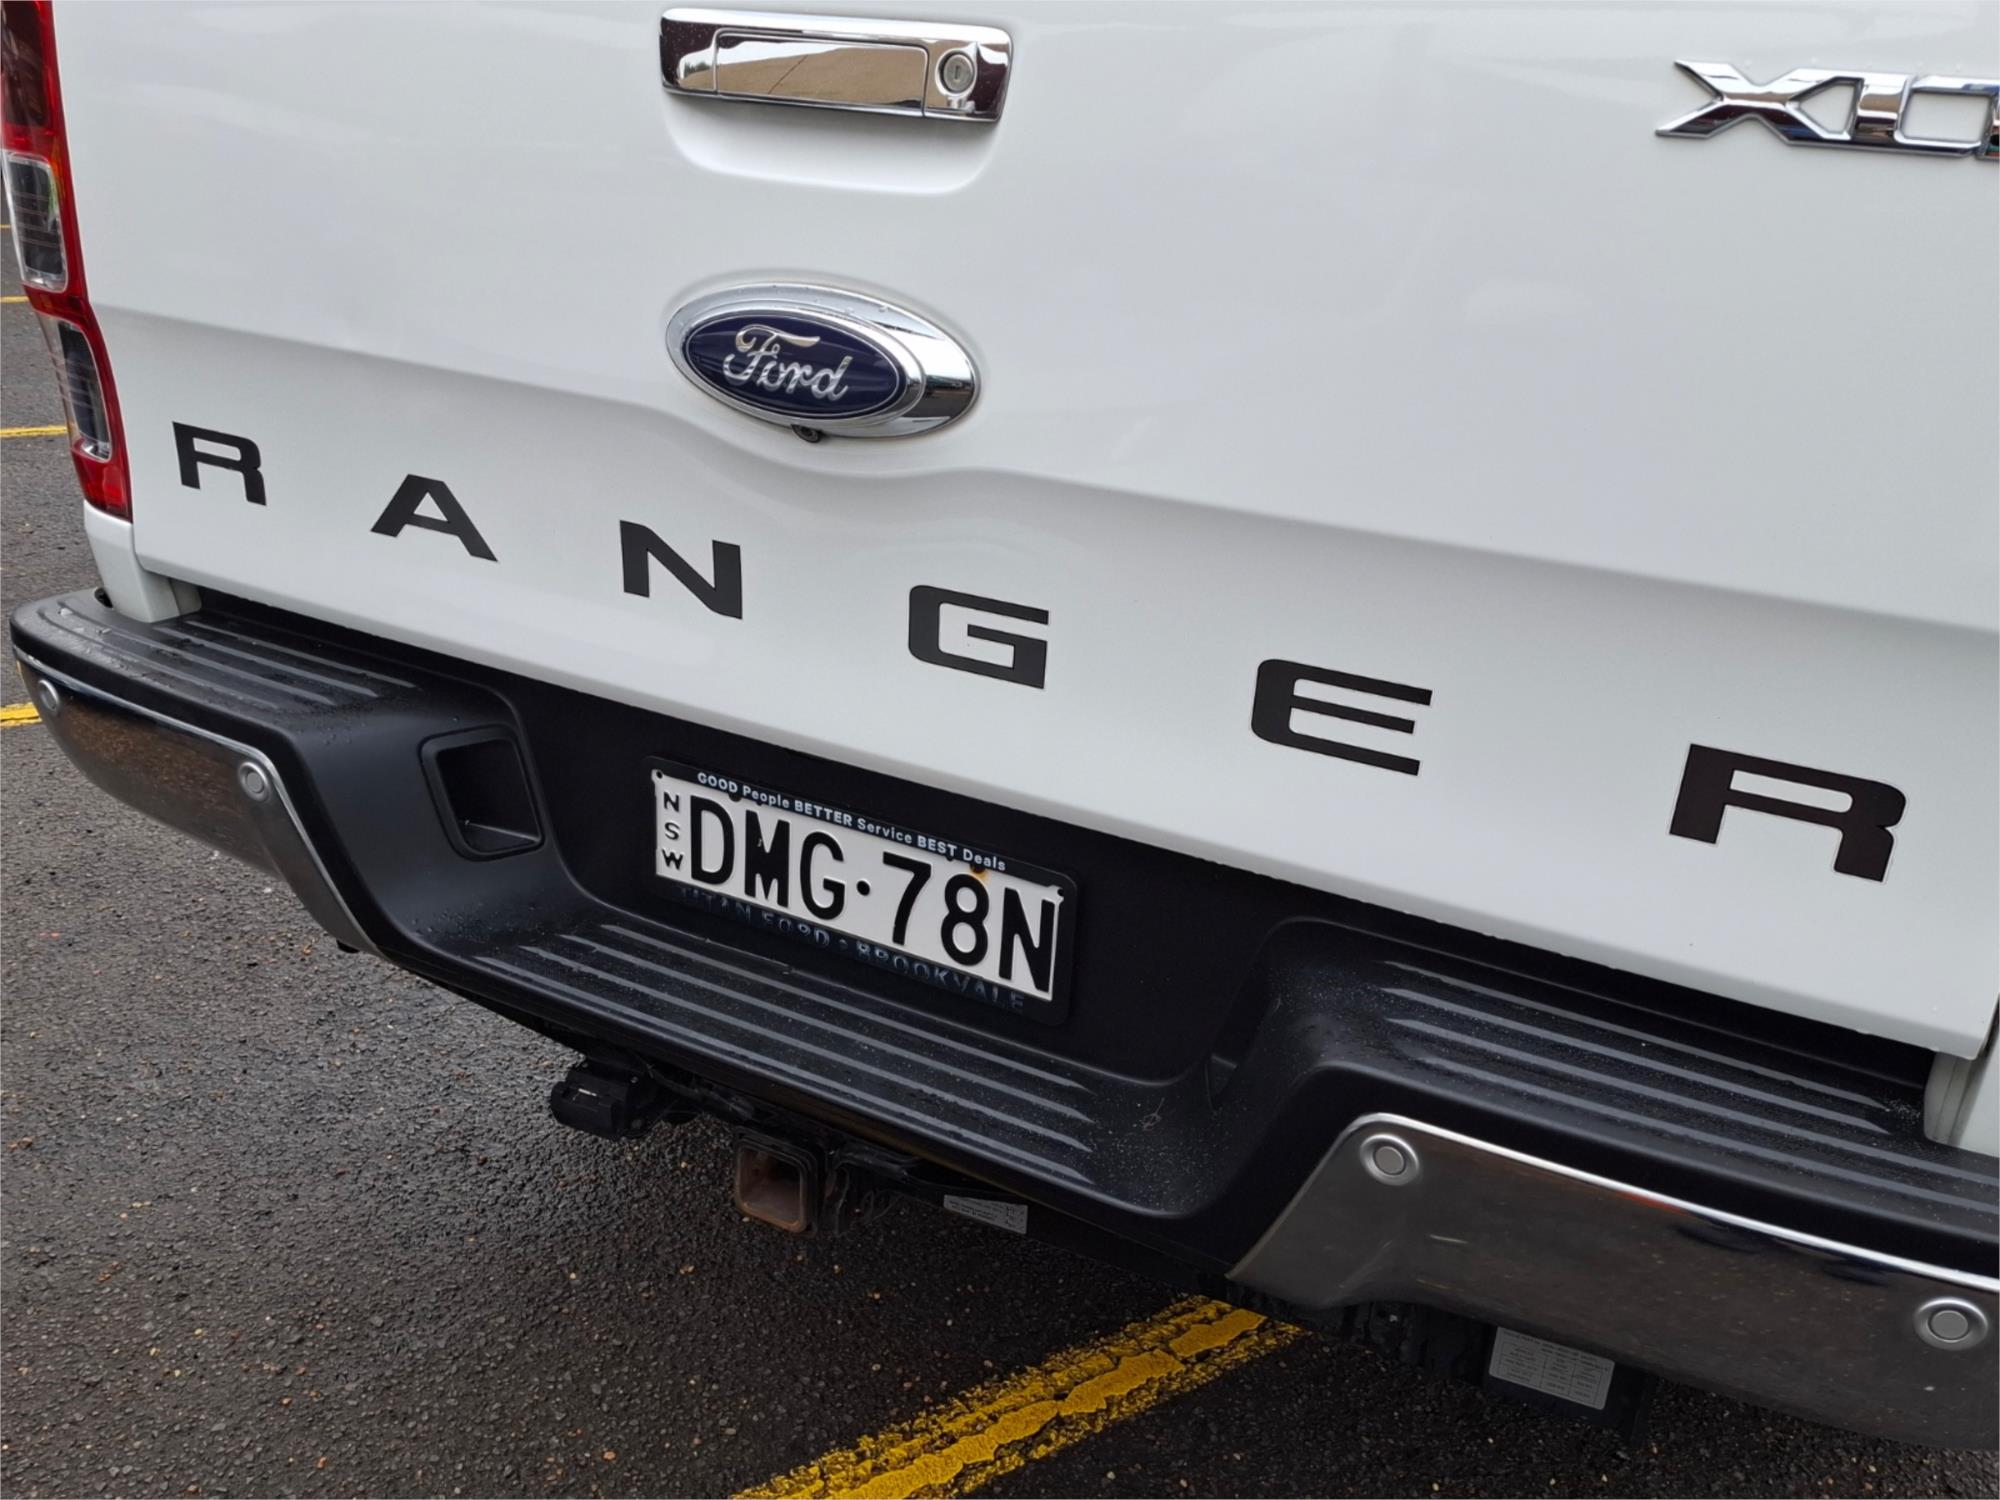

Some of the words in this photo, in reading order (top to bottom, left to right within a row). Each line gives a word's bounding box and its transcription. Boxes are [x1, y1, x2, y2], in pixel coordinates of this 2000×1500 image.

[722, 323, 854, 402] Ford
[172, 421, 1906, 882] RANGER
[696, 771, 739, 794] GOOD
[742, 784, 790, 809] People
[794, 800, 853, 828] BETTER
[856, 817, 913, 845] Service
[917, 834, 958, 857] BEST
[962, 848, 1007, 872] Deals
